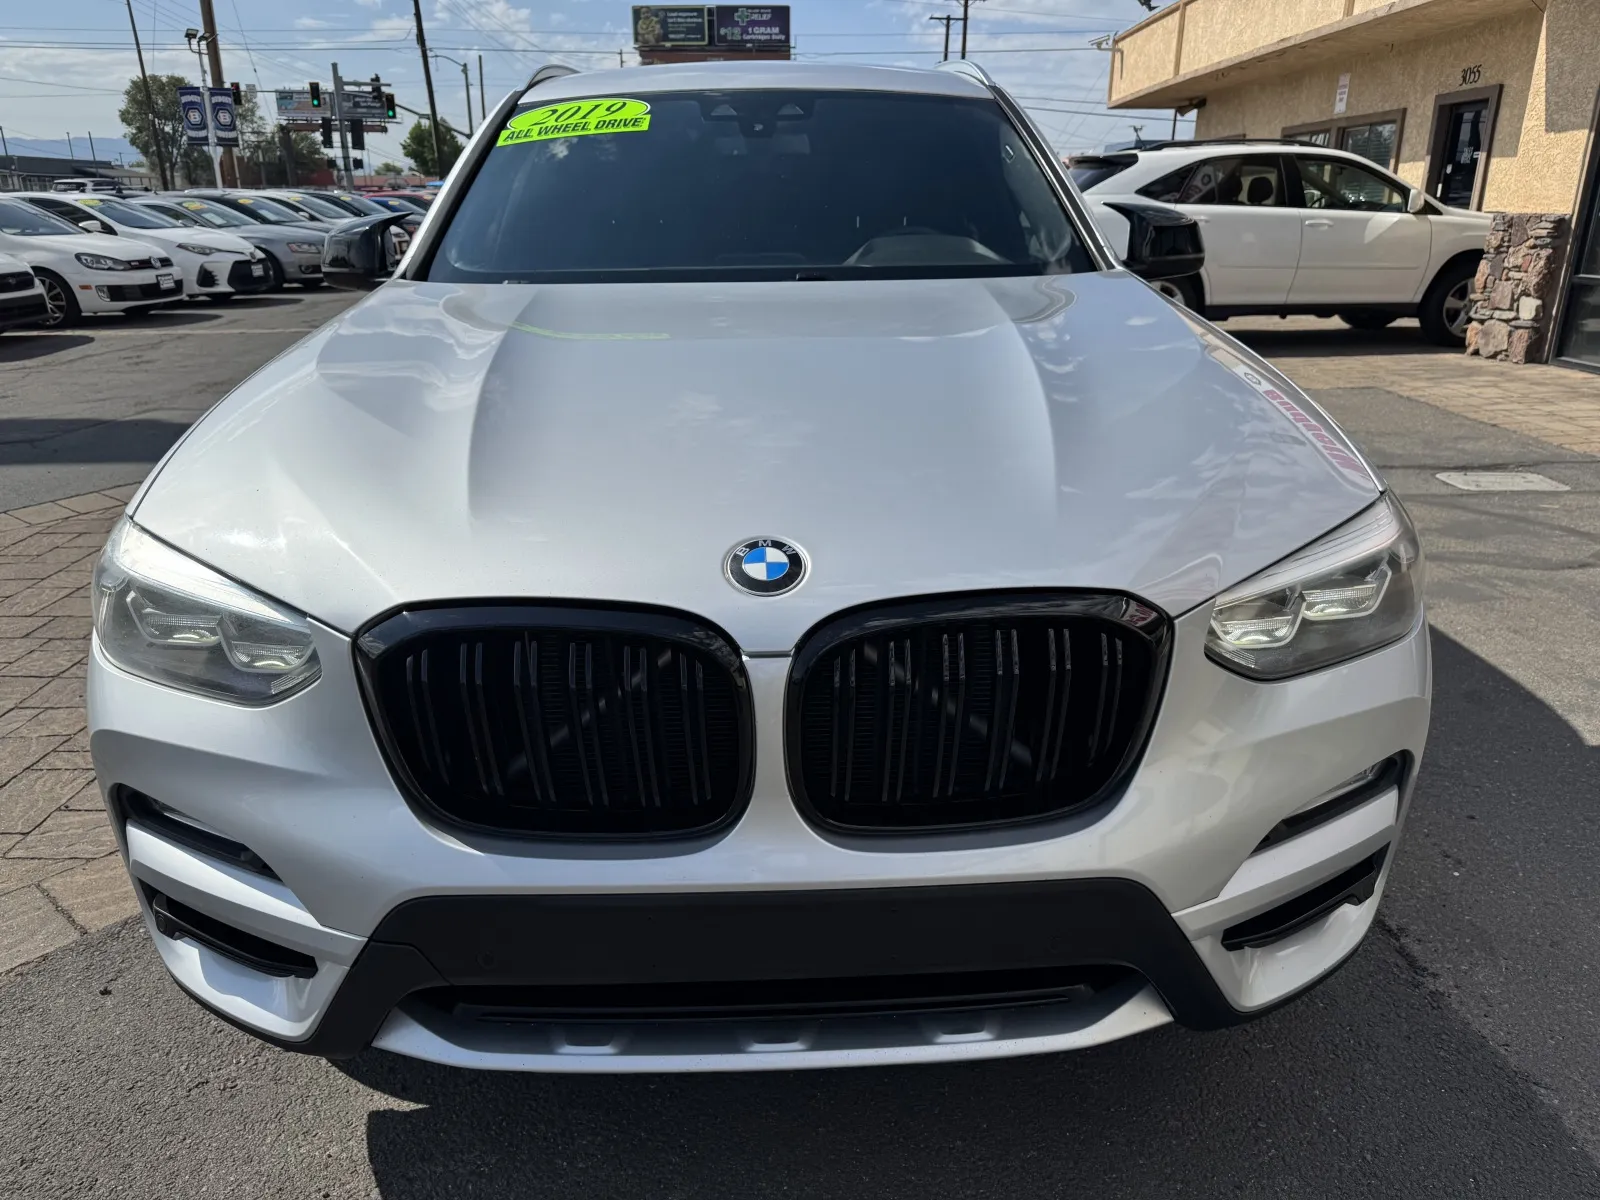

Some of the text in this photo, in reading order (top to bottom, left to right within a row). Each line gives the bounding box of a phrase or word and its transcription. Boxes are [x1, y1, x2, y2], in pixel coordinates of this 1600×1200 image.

[1459, 64, 1482, 86] 3055
[531, 101, 627, 126] 2019
[503, 117, 646, 142] ALL WHEEL DRIVE
[735, 540, 797, 557] BMW
